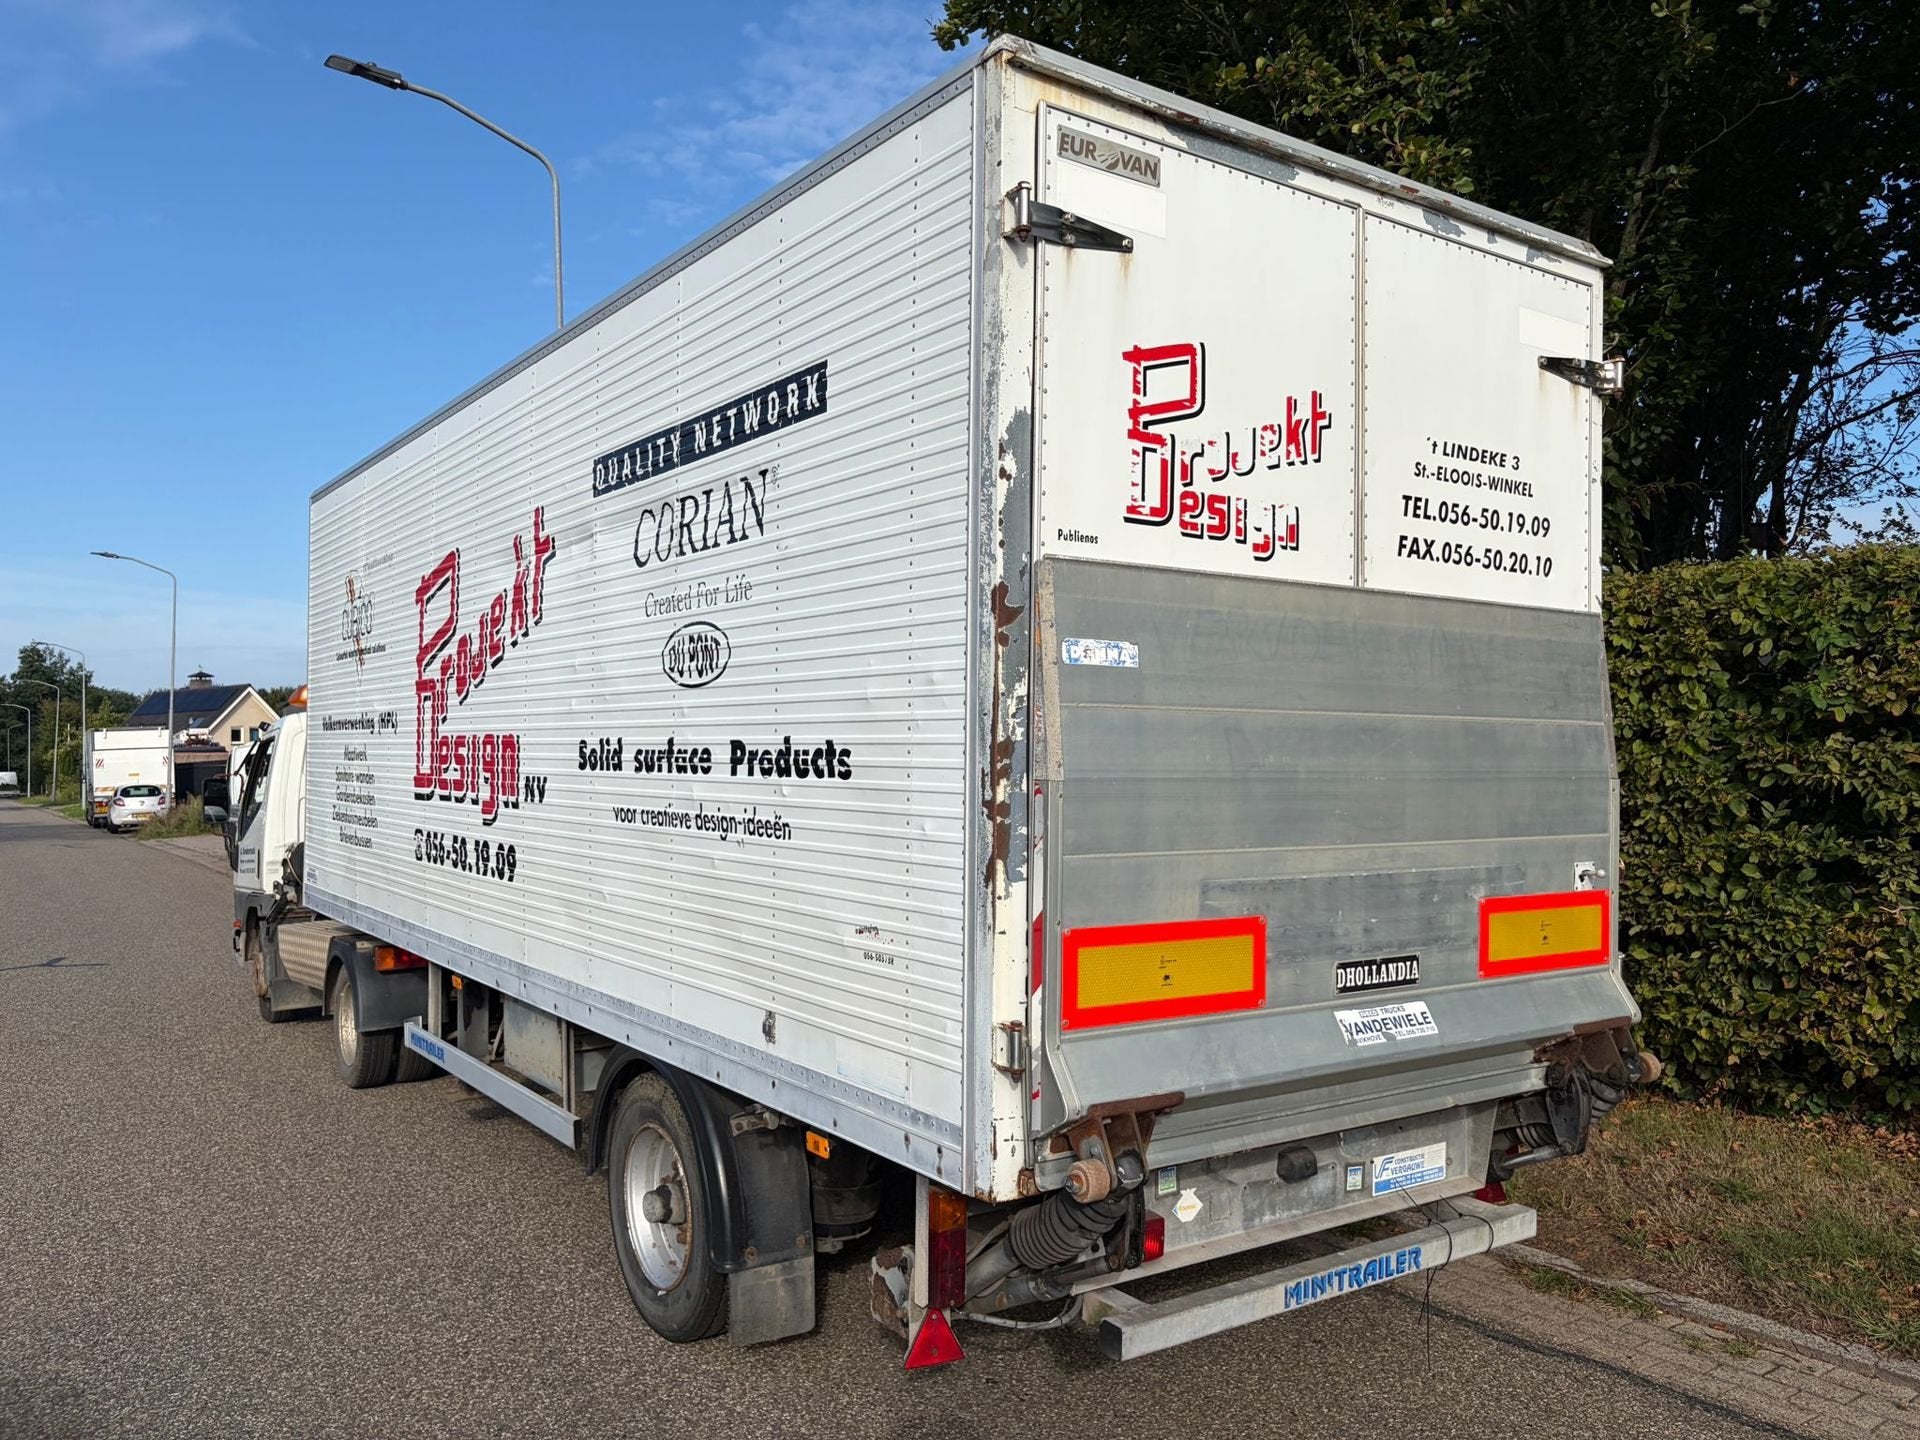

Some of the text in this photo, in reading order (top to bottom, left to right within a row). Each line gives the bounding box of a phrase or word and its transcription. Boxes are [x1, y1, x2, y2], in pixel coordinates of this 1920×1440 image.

[596, 372, 820, 490] QUALITY NETWORK
[1442, 441, 1507, 468] LINDEKE
[1511, 456, 1520, 471] 3
[1413, 461, 1534, 498] St.-ELOOIS-WINKEL
[633, 468, 769, 568] CORIAN
[1057, 528, 1099, 546] Publienos
[1402, 494, 1551, 538] TEL.056-50.19.09
[1397, 534, 1553, 578] FAX.056-50.20.10
[645, 573, 753, 617] Created For Life
[413, 678, 547, 826] Design NV
[578, 736, 853, 781] Solid surface Products
[613, 803, 792, 842] voor creatieve design-ideeën
[425, 830, 517, 882] 056-50.19.09
[1336, 957, 1419, 989] DHOLLANDIA
[1341, 1011, 1432, 1037] VANDEWIELE
[1380, 1006, 1406, 1016] TRUCKS
